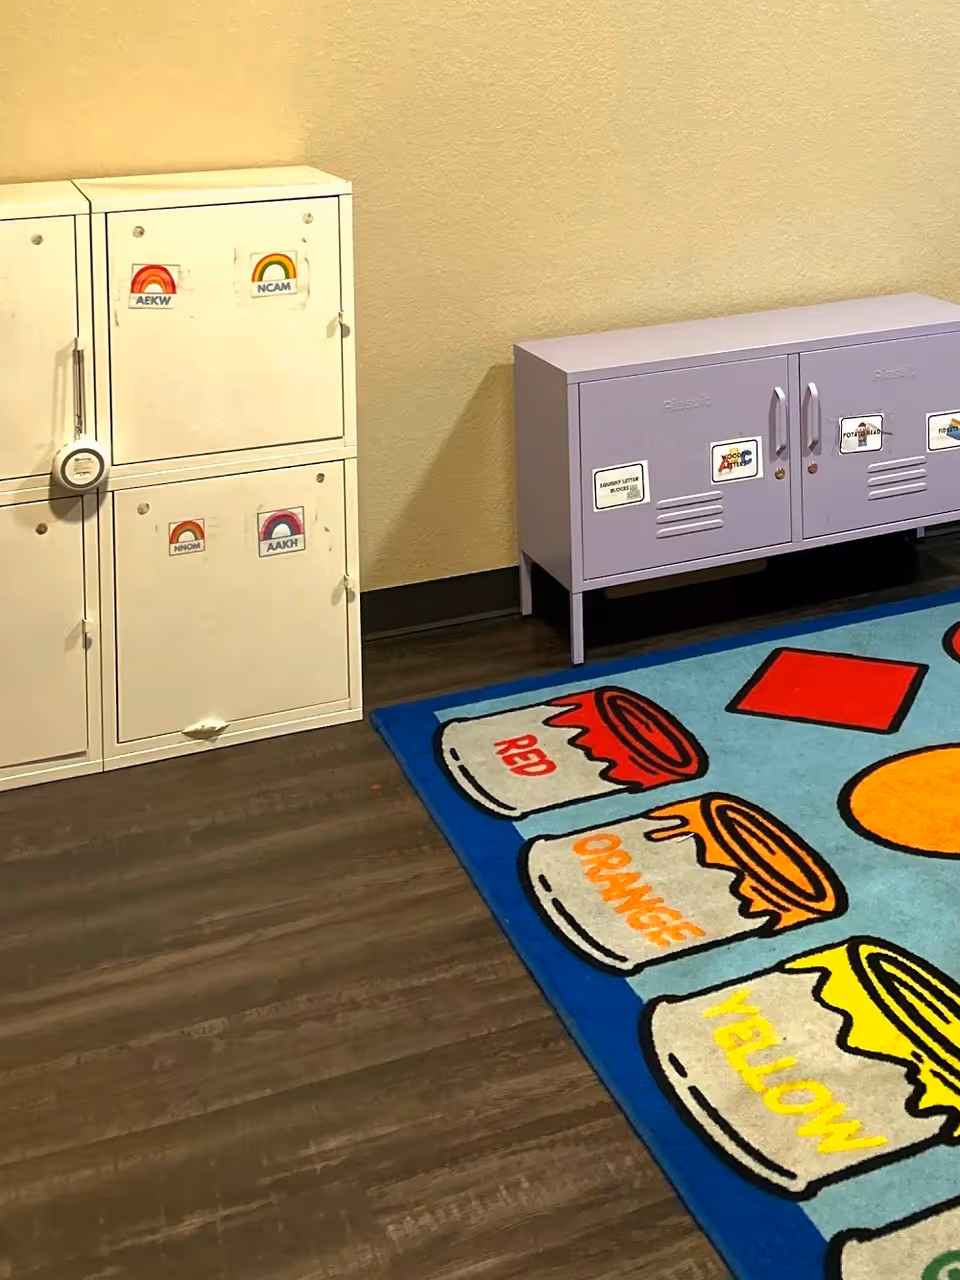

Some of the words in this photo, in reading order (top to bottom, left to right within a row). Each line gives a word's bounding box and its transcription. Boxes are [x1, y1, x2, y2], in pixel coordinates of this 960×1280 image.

[256, 281, 292, 293] NCAM
[135, 295, 172, 306] AEKW
[622, 476, 639, 484] LETTER
[610, 485, 630, 493] BLOCKS
[266, 538, 298, 552] AAKH
[493, 734, 557, 778] RED
[572, 832, 706, 948] ORANGE
[703, 988, 889, 1154] YELLOW
